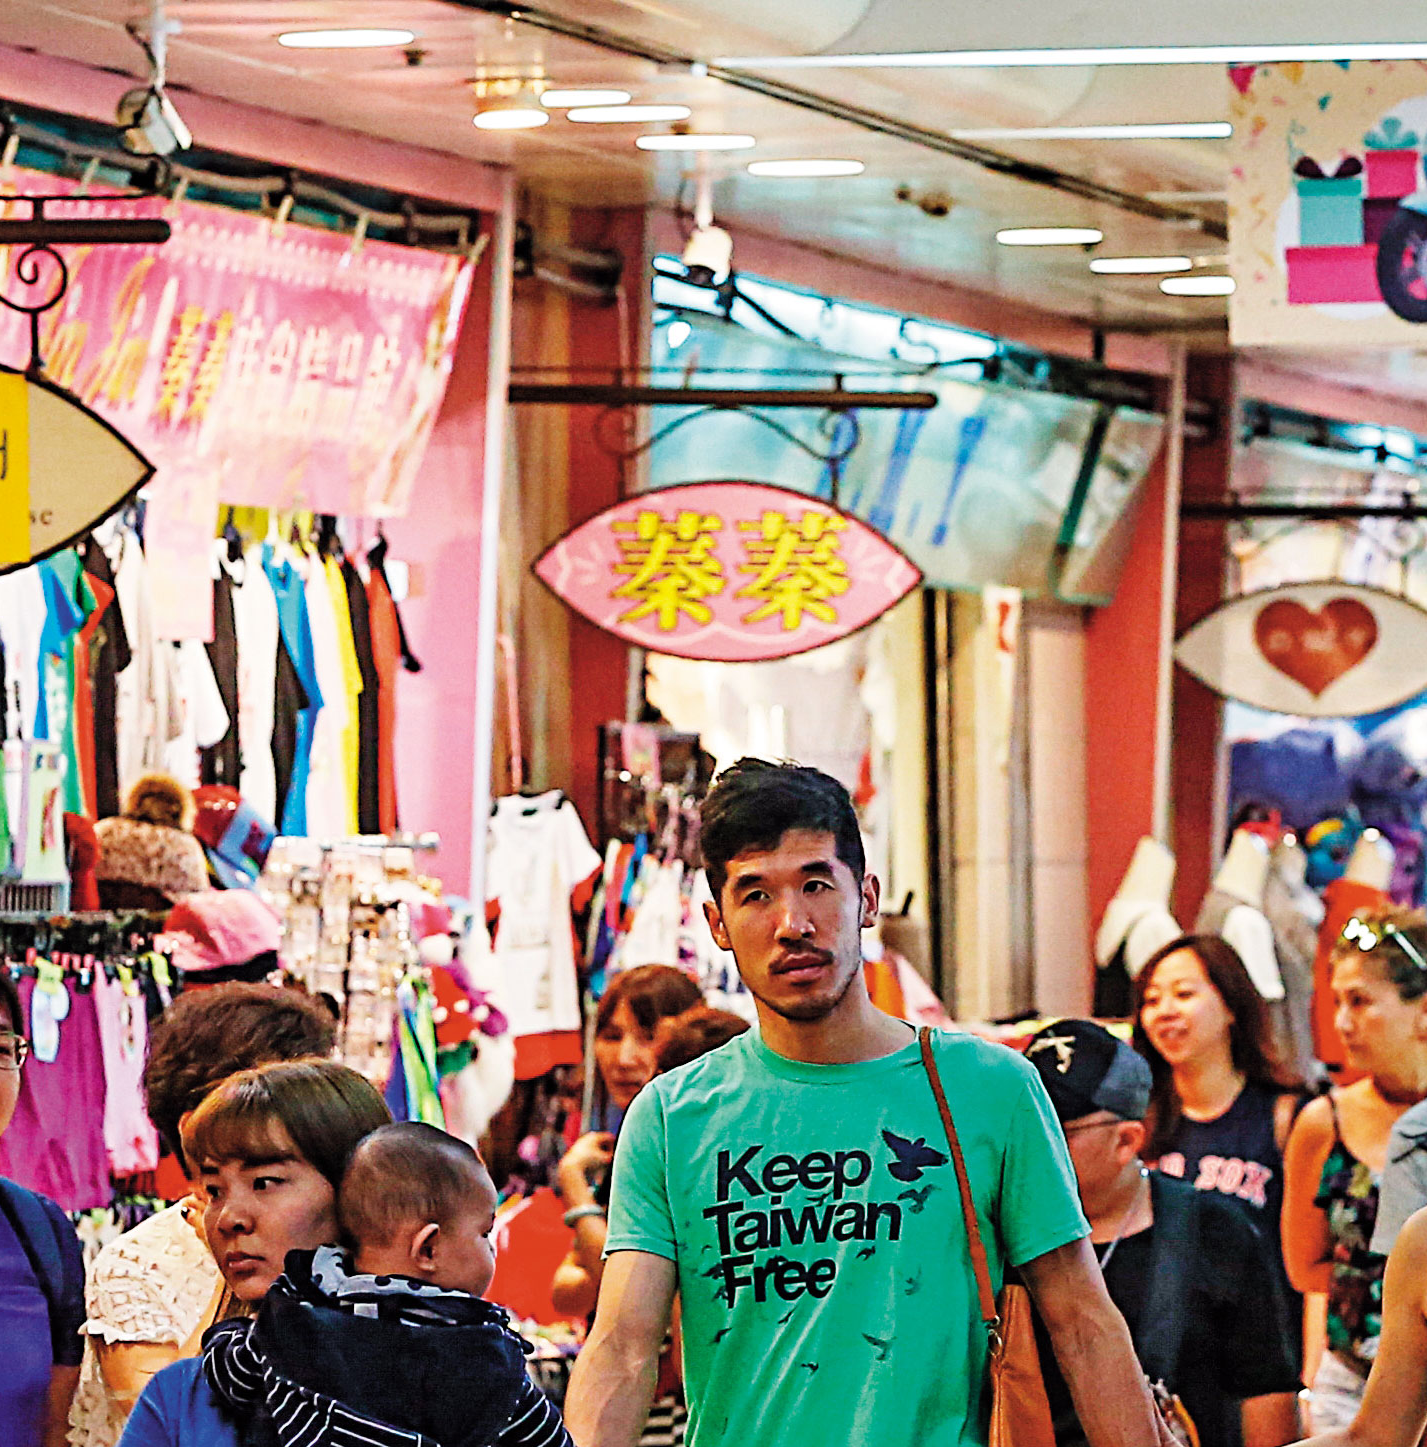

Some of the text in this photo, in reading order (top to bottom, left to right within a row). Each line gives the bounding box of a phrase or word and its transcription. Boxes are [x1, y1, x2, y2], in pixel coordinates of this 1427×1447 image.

[717, 1145, 872, 1201] Keep
[703, 1196, 902, 1256] Taiwan
[722, 1255, 837, 1309] Free
